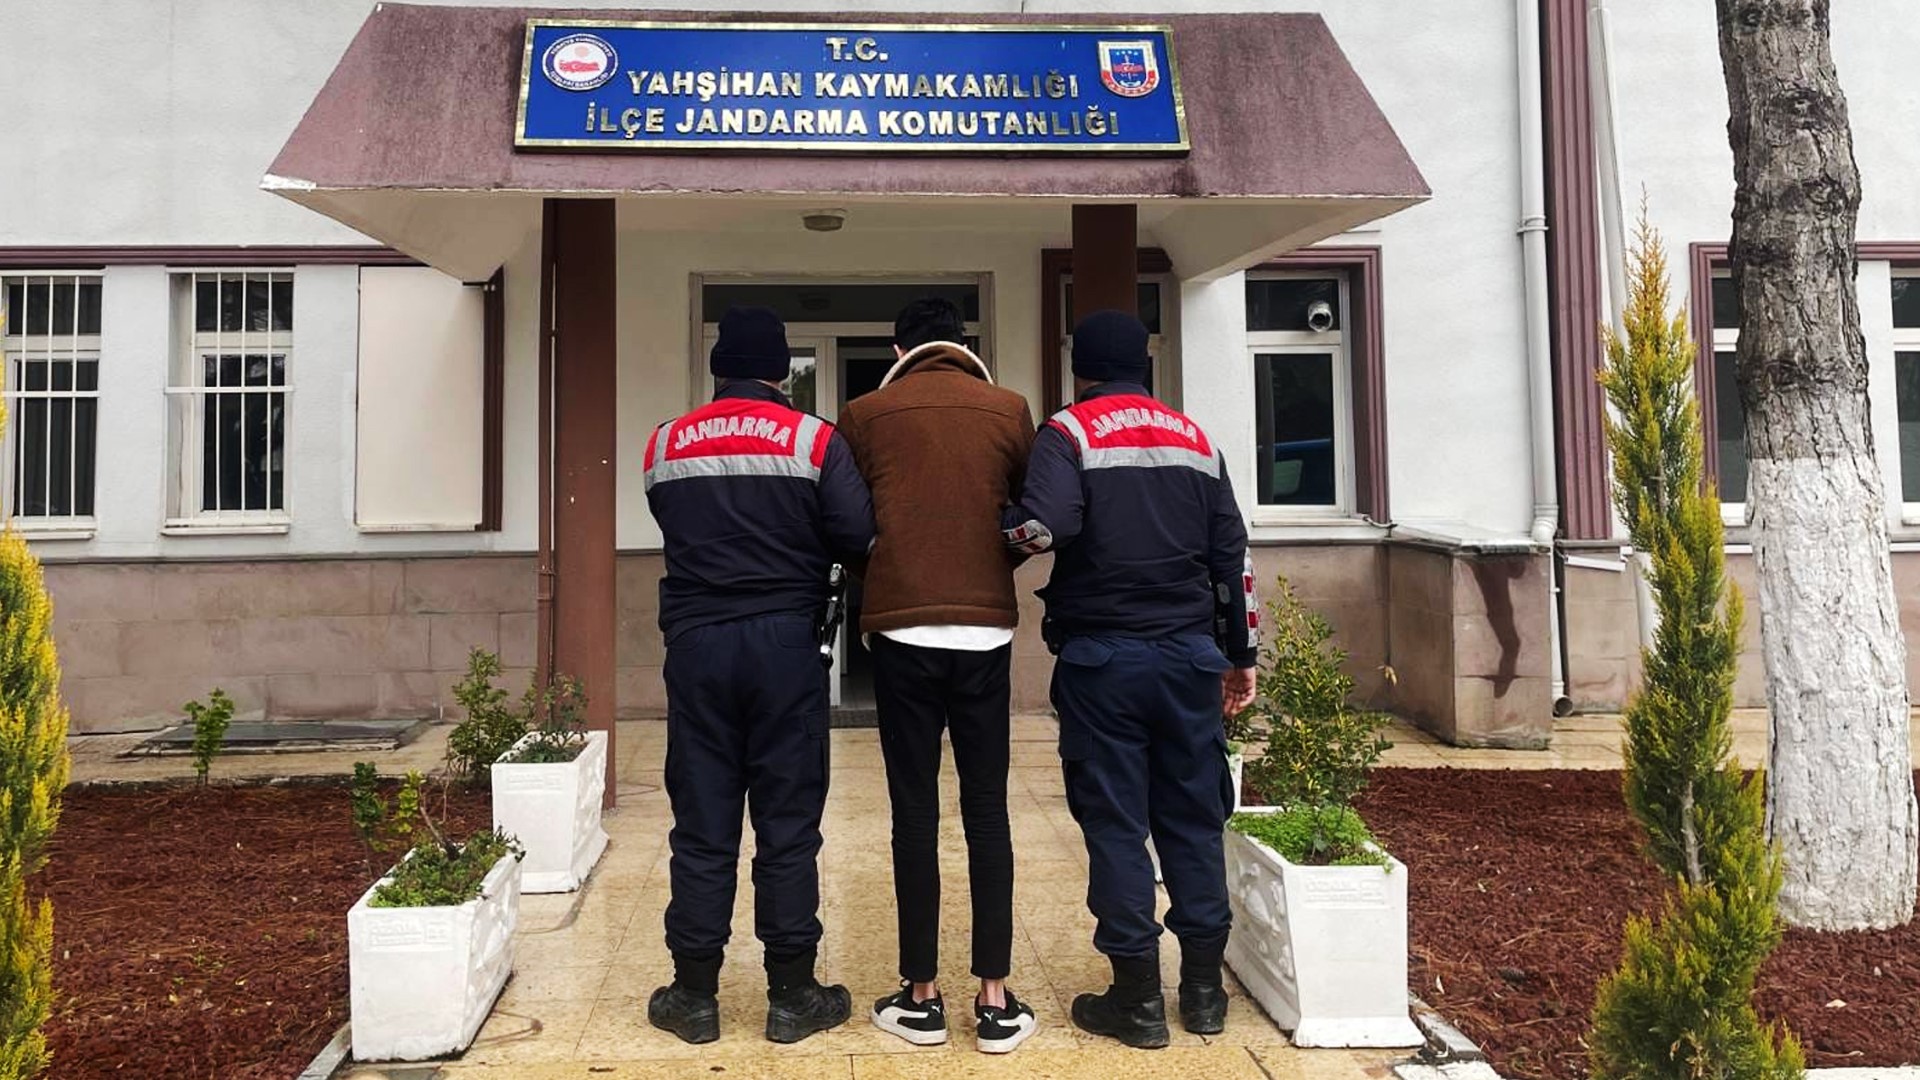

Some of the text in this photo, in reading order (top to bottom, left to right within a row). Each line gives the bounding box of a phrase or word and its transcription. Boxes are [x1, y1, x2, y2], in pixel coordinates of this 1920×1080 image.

[825, 36, 888, 61] T.C.
[627, 67, 801, 102] YAHŞİHAN
[814, 69, 1079, 98] KAYMAKAMLIĞI
[585, 101, 1120, 138] İLÇE JANDARMA KOMUTANLIĞI
[674, 415, 792, 450] JANDARMA
[1091, 407, 1198, 444] JANDARMA
